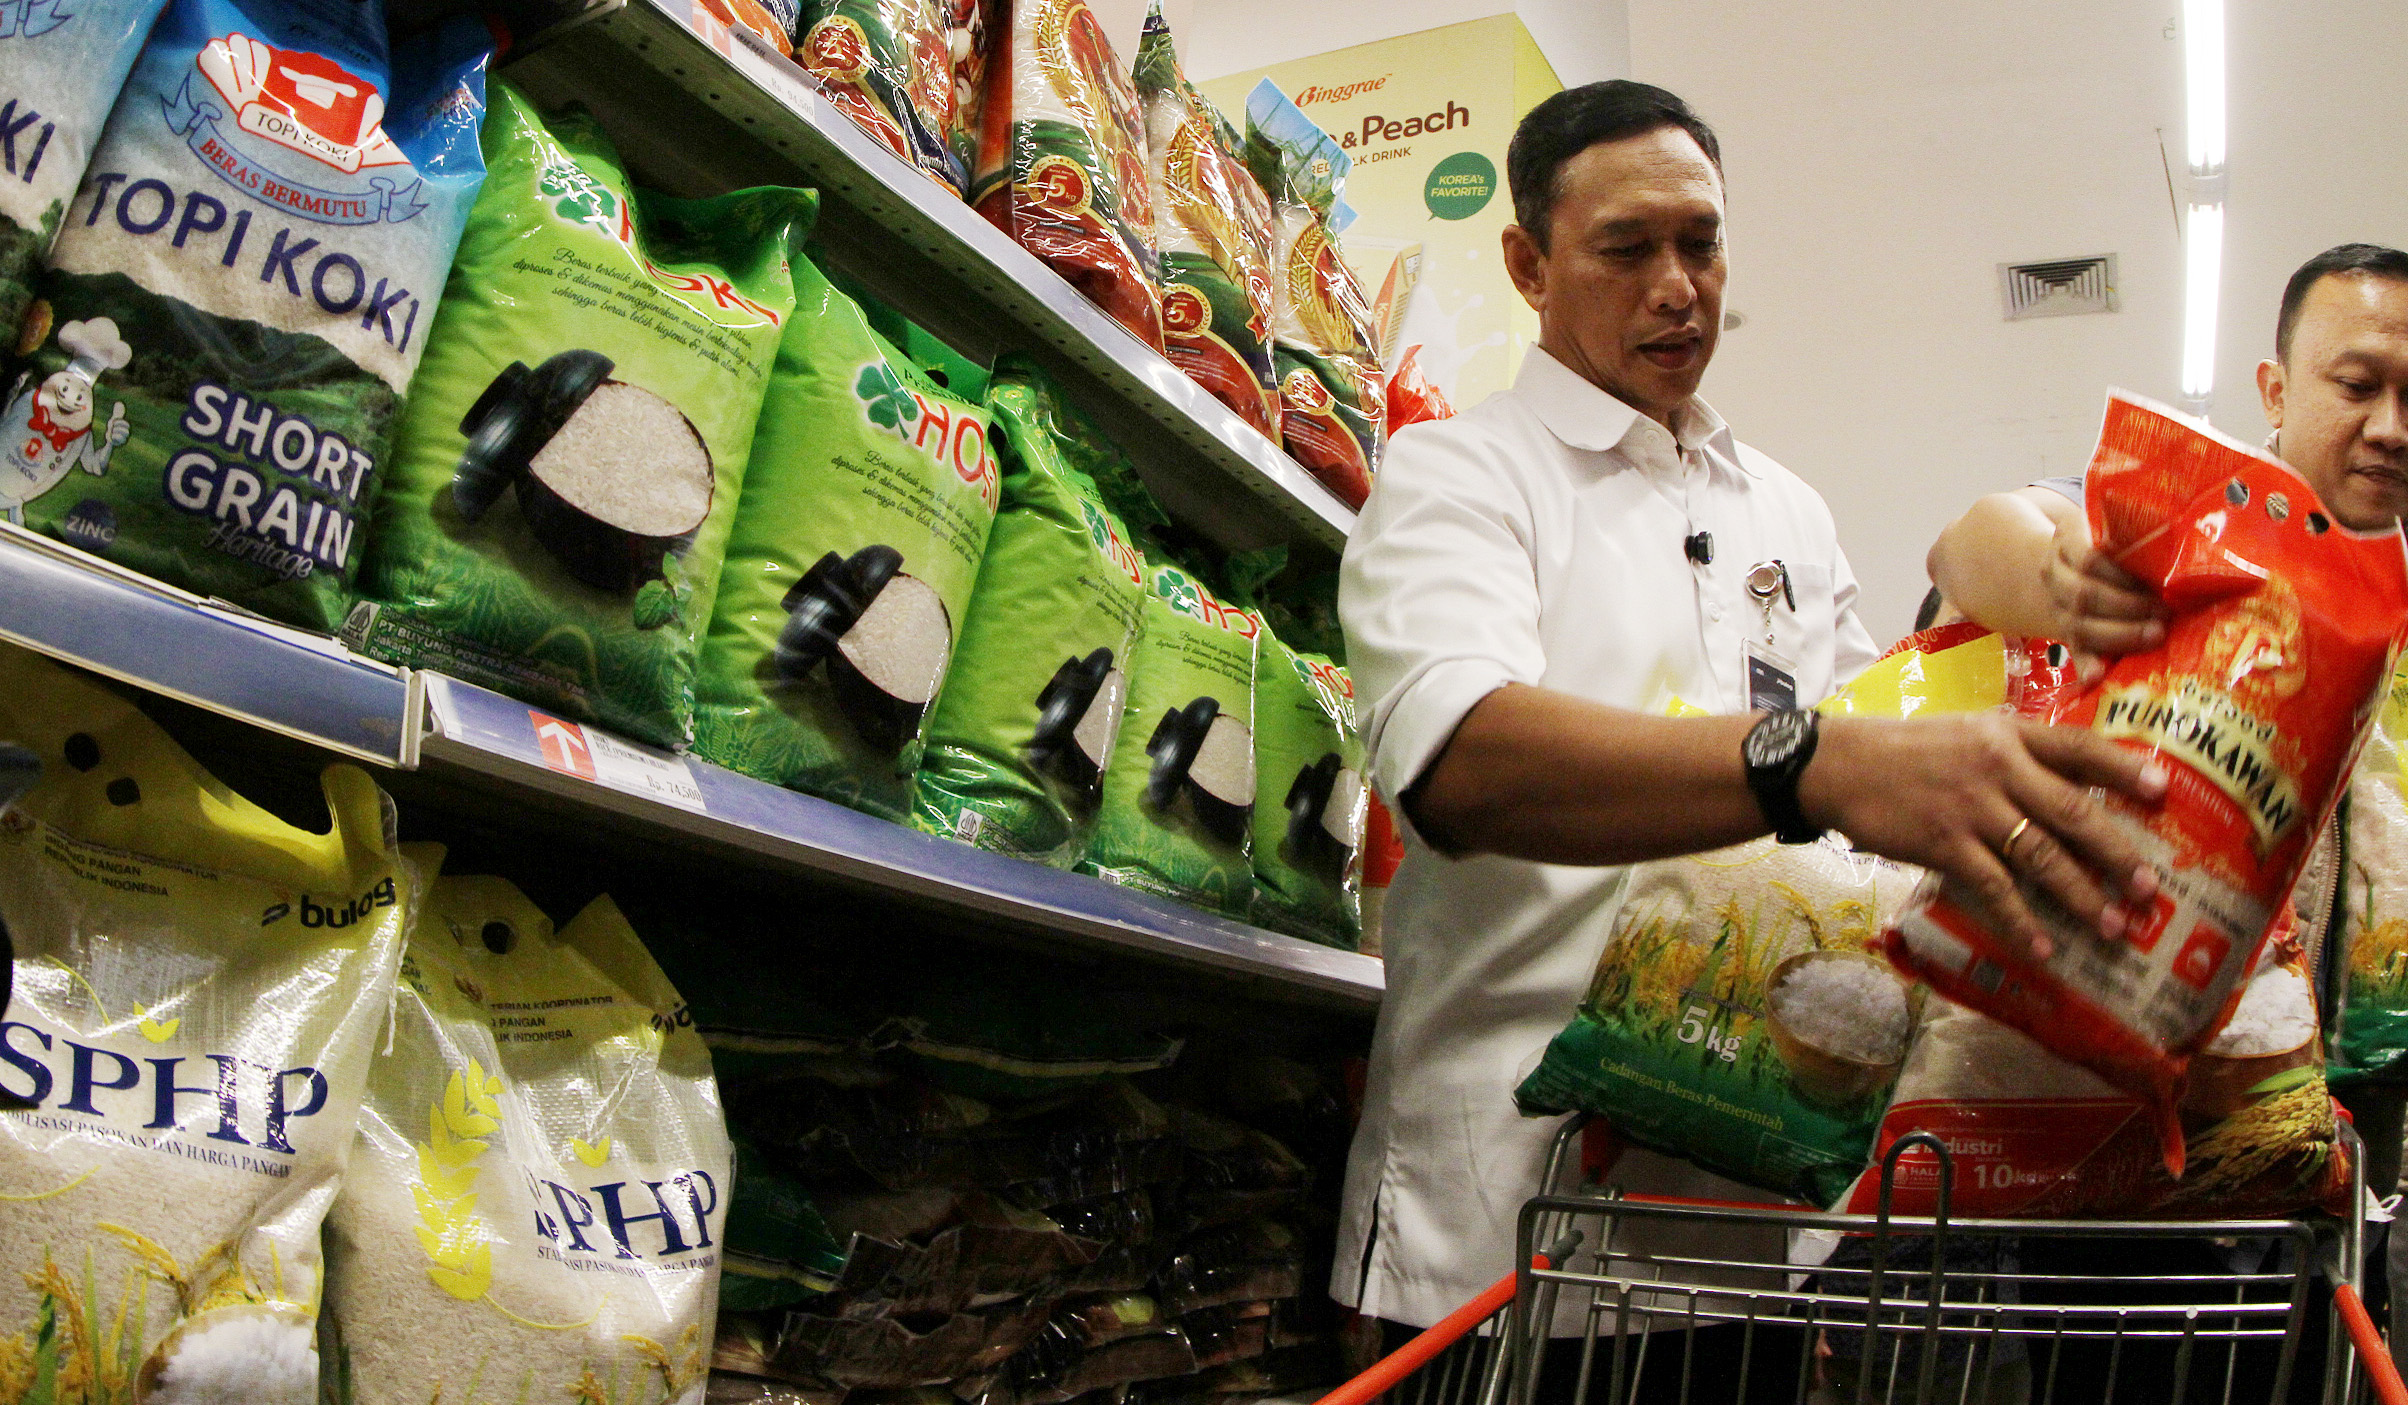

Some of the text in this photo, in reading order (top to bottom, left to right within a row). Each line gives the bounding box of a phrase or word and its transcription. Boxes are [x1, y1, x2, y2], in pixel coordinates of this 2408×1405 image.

[1295, 76, 1387, 108] Binggrae
[257, 111, 304, 144] TOPI
[1362, 100, 1470, 147] Peach
[1371, 146, 1412, 164] DRINK
[199, 137, 368, 220] BERAS BERMUTU
[1430, 186, 1489, 198] FAVORITE!
[86, 172, 420, 355] TOPI KOKI
[552, 247, 592, 271] Beras
[185, 383, 373, 501] SHORT
[168, 451, 355, 570] GRAIN
[66, 514, 116, 545] ZINC
[203, 520, 314, 579] Heritage
[373, 634, 413, 656] Jakarta
[378, 619, 396, 634] PT
[397, 626, 453, 656] BUYUNG
[2106, 700, 2292, 833] PUNOKAWAN
[666, 780, 703, 803] 74,500
[101, 876, 170, 898] INDONESIA
[300, 876, 398, 930] bulog
[500, 1016, 547, 1028] PANGAN
[513, 1028, 574, 1043] INDONESIA
[0, 1021, 329, 1155] SPHP
[1600, 1056, 1663, 1092] Cadangan
[1666, 1080, 1703, 1103] Beras
[1706, 1093, 1785, 1133] Pemerintah
[187, 1144, 238, 1169] HARGA
